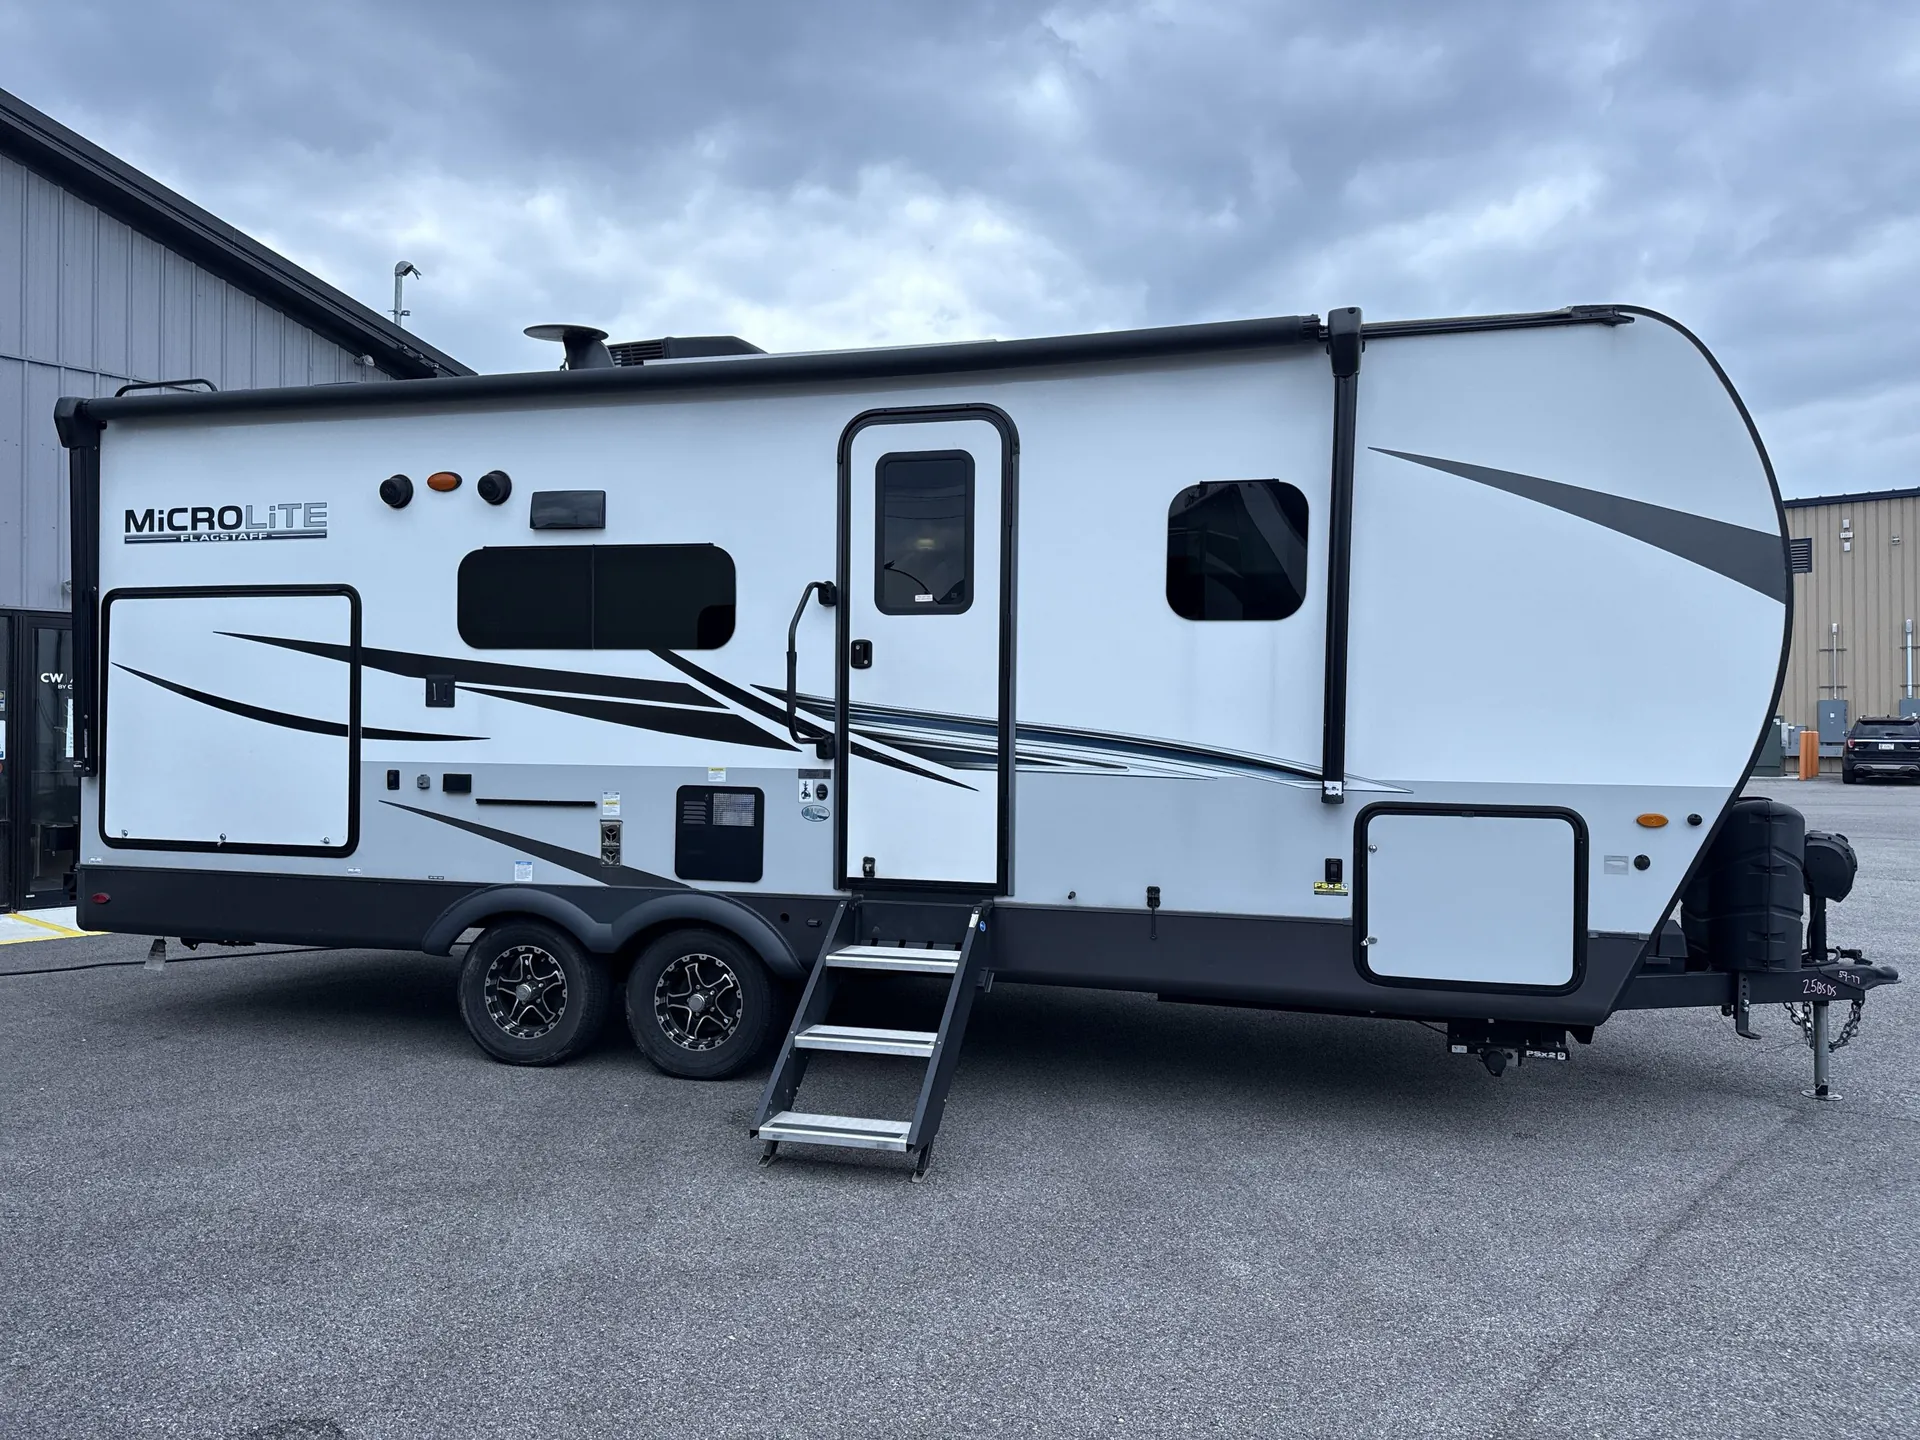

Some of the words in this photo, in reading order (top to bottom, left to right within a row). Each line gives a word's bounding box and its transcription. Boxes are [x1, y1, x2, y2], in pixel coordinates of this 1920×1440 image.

[125, 502, 327, 533] MiCROLiTE
[180, 532, 268, 542] FLAGSTAFF
[40, 673, 63, 683] CW
[1526, 1050, 1556, 1059] PSx2
